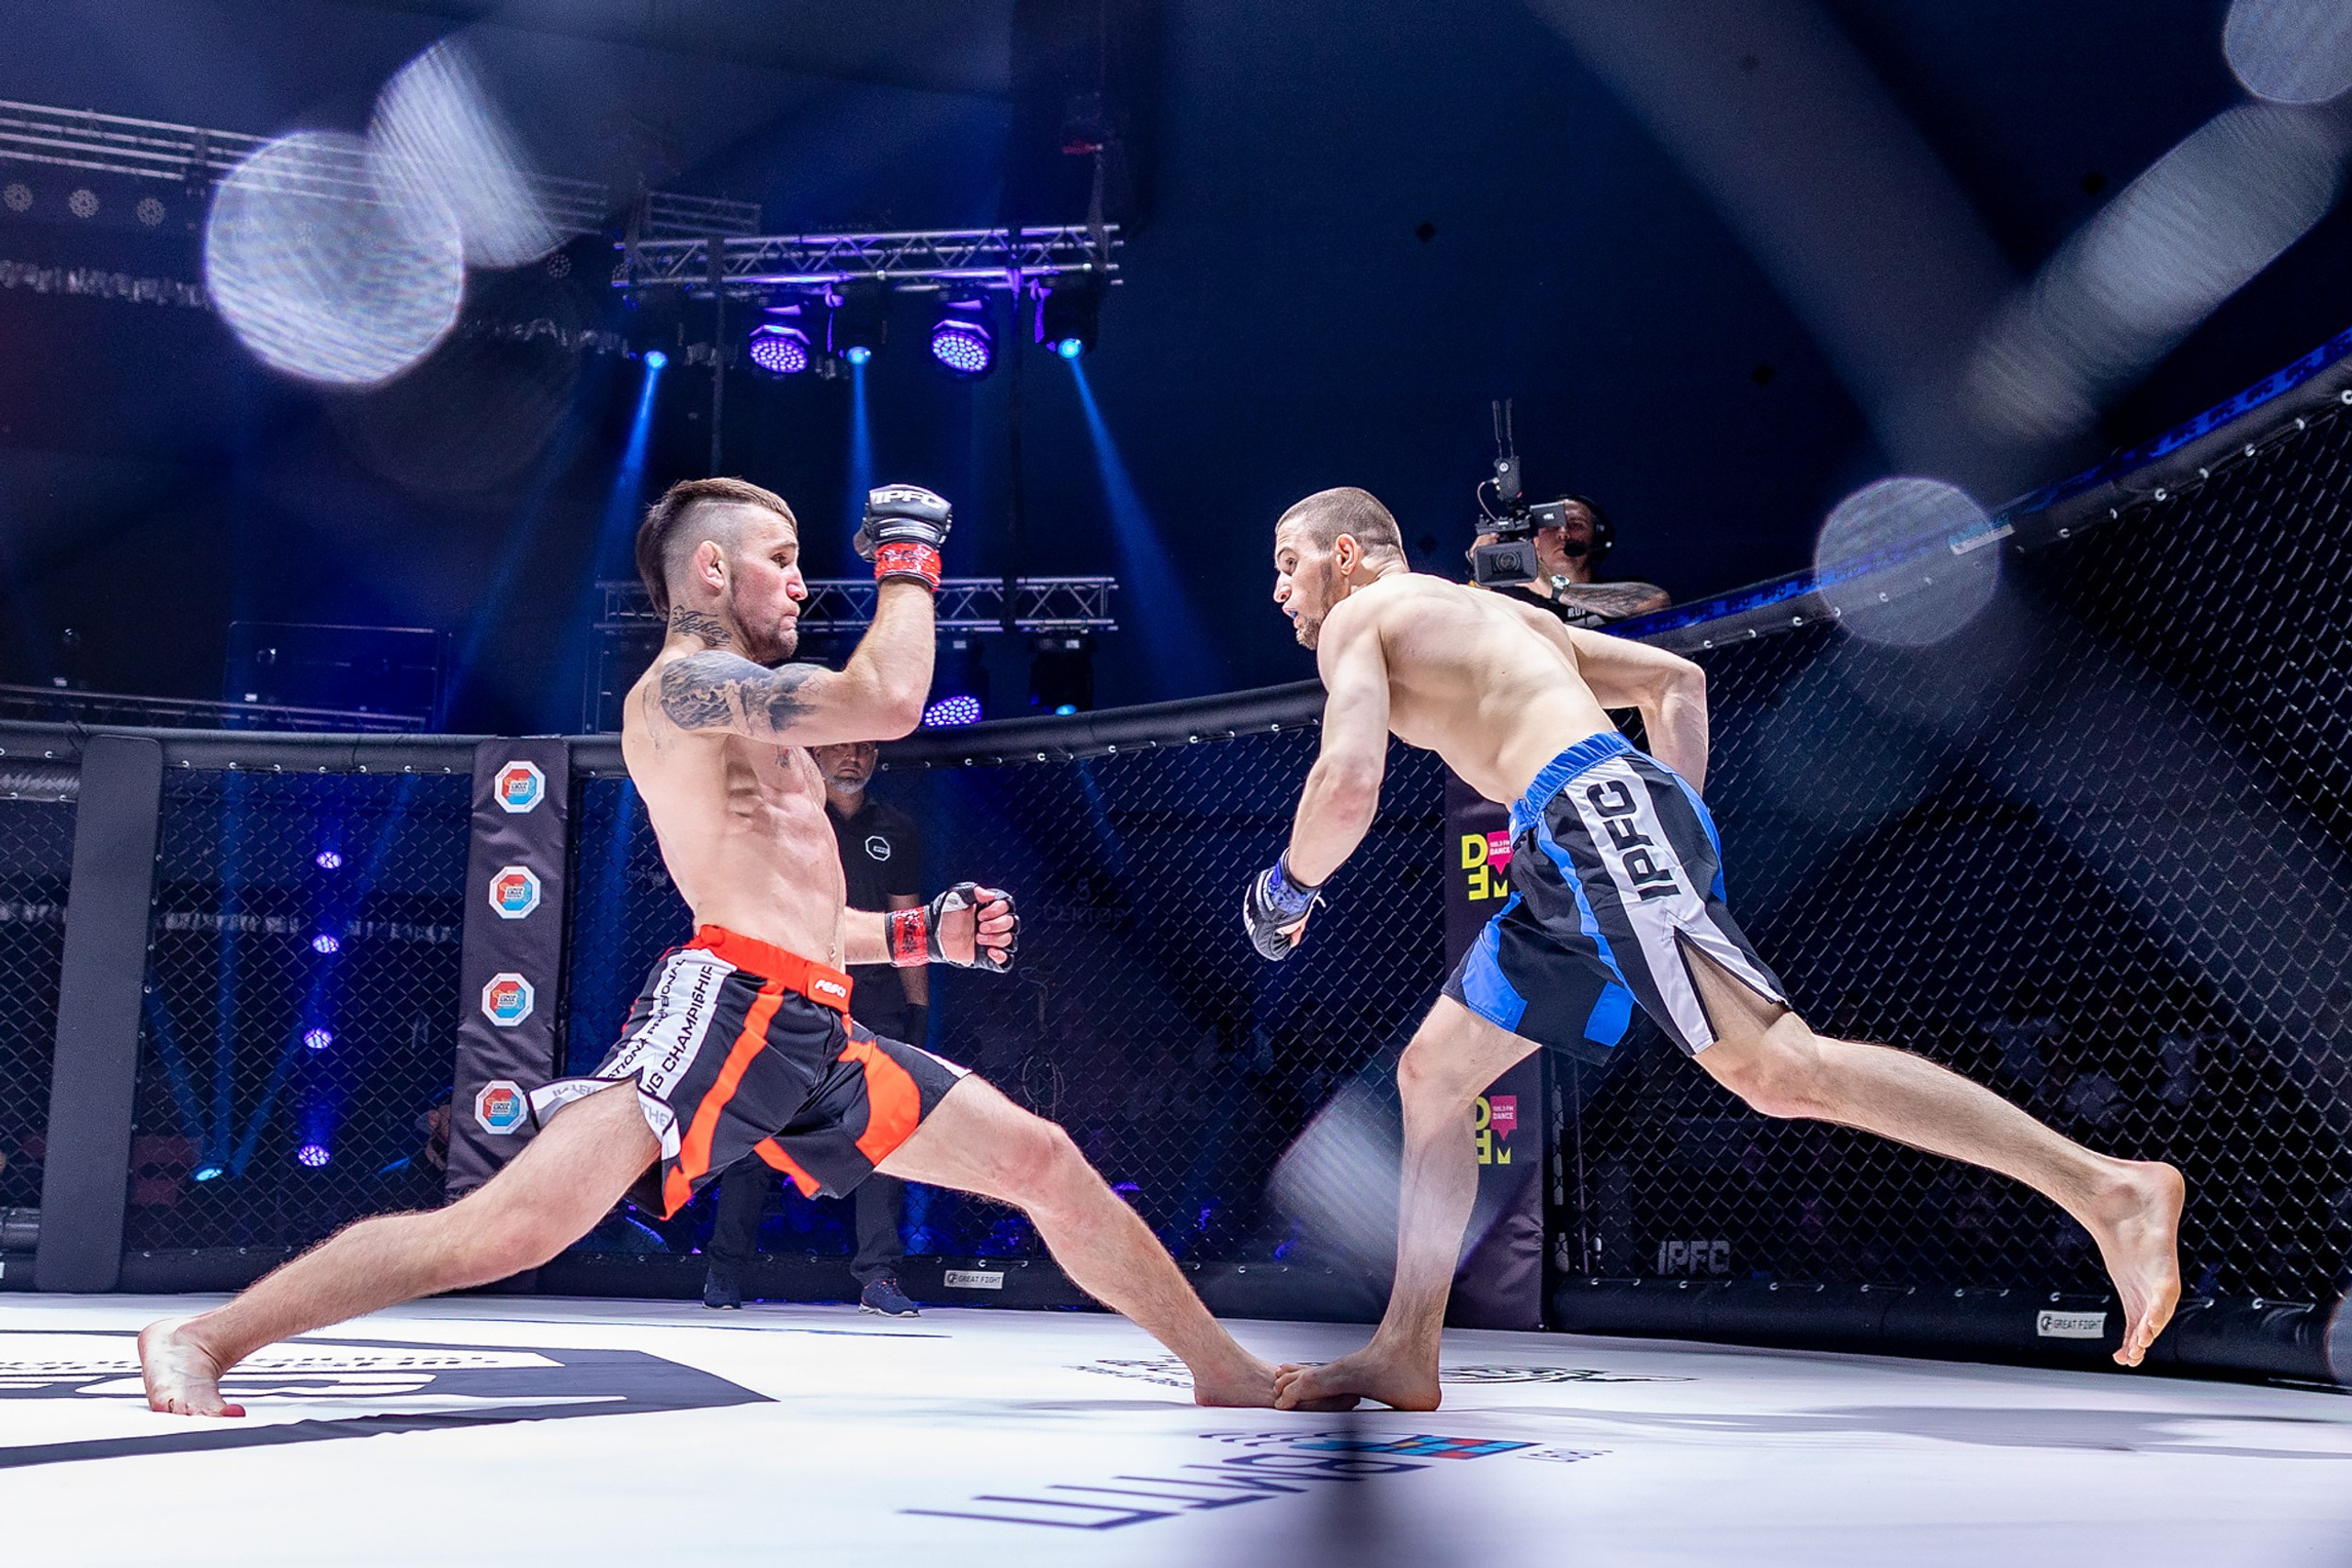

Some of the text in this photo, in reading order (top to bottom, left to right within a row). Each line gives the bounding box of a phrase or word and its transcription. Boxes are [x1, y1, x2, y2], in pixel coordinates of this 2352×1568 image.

[870, 490, 944, 510] IPFC
[1587, 780, 1682, 902] IPFC
[1489, 846, 1510, 855] DANCE
[1493, 1111, 1514, 1120] DANCE
[1657, 1240, 1731, 1275] IPFC
[958, 1274, 1002, 1284] GREAT FIGHT
[2053, 1319, 2102, 1330] GREAT FIGHT
